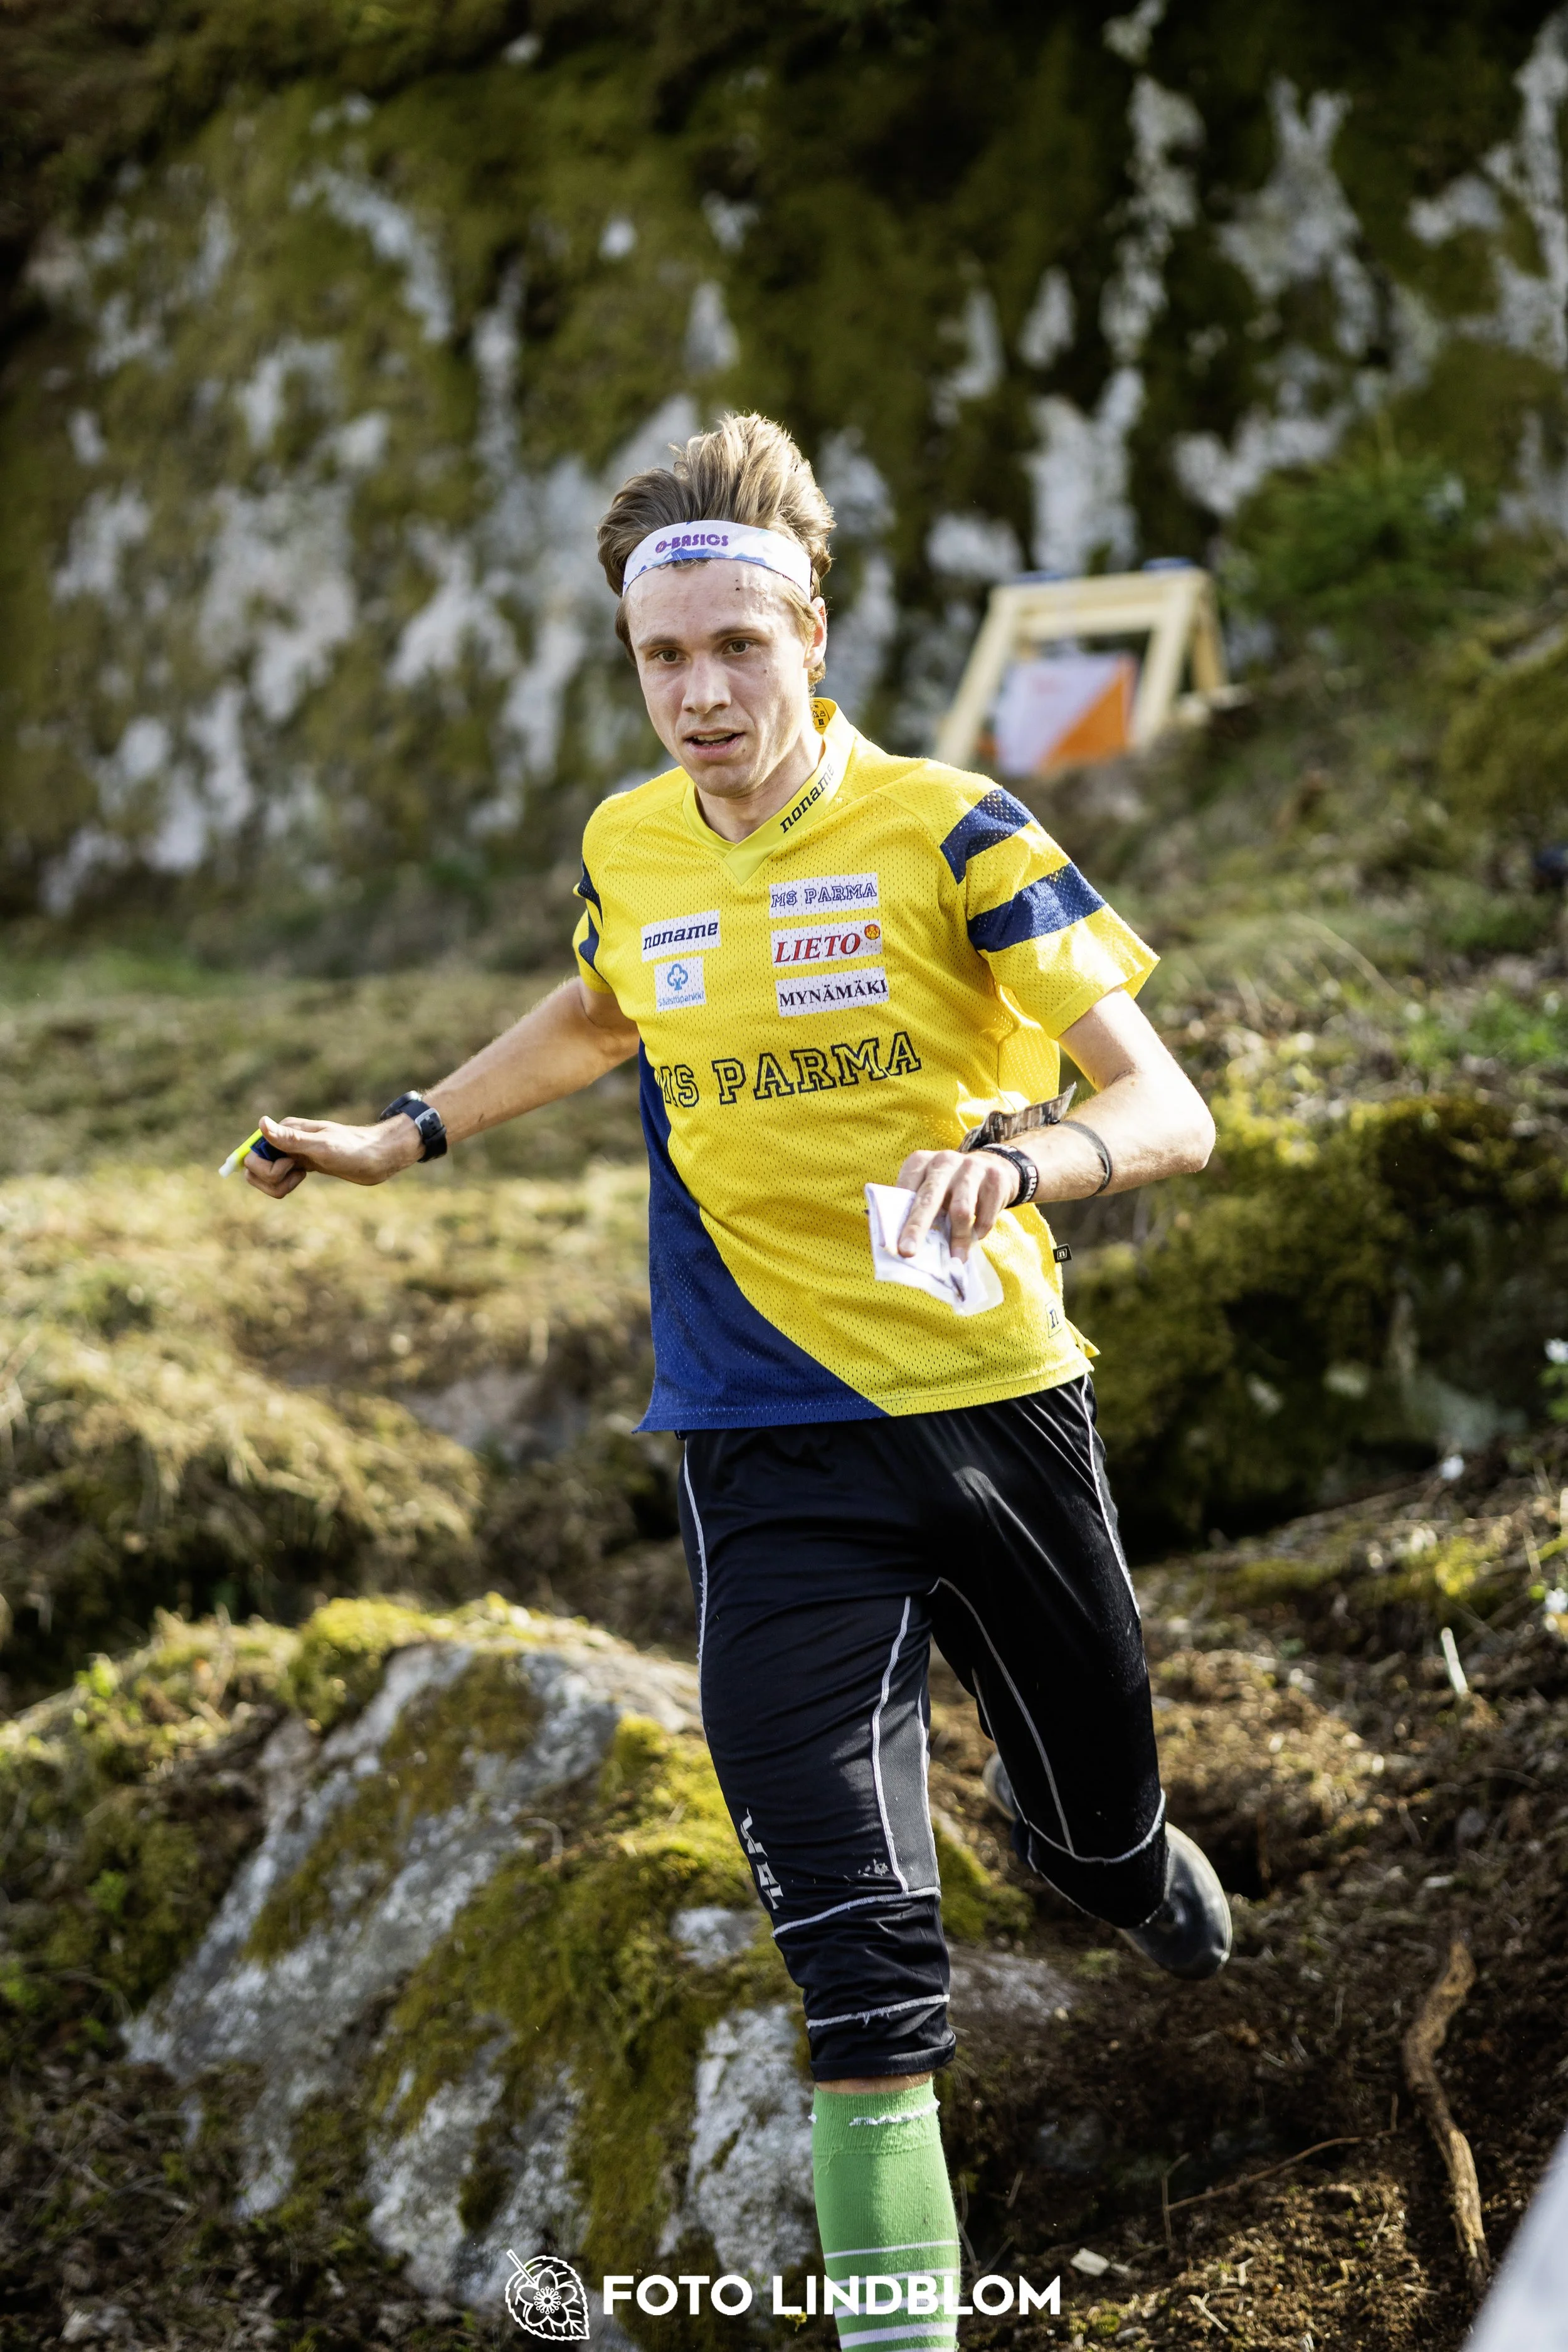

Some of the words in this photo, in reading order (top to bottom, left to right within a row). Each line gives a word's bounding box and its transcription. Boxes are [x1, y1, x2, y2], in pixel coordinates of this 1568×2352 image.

[655, 533, 729, 553] O-BASICS
[780, 763, 835, 834] noname
[771, 890, 797, 908] MS
[805, 882, 877, 904] PARMA
[643, 921, 718, 950] noname
[773, 932, 861, 963] LIETO
[779, 978, 887, 1007] MYNÄMÄKI
[711, 1031, 922, 1105] PARMA
